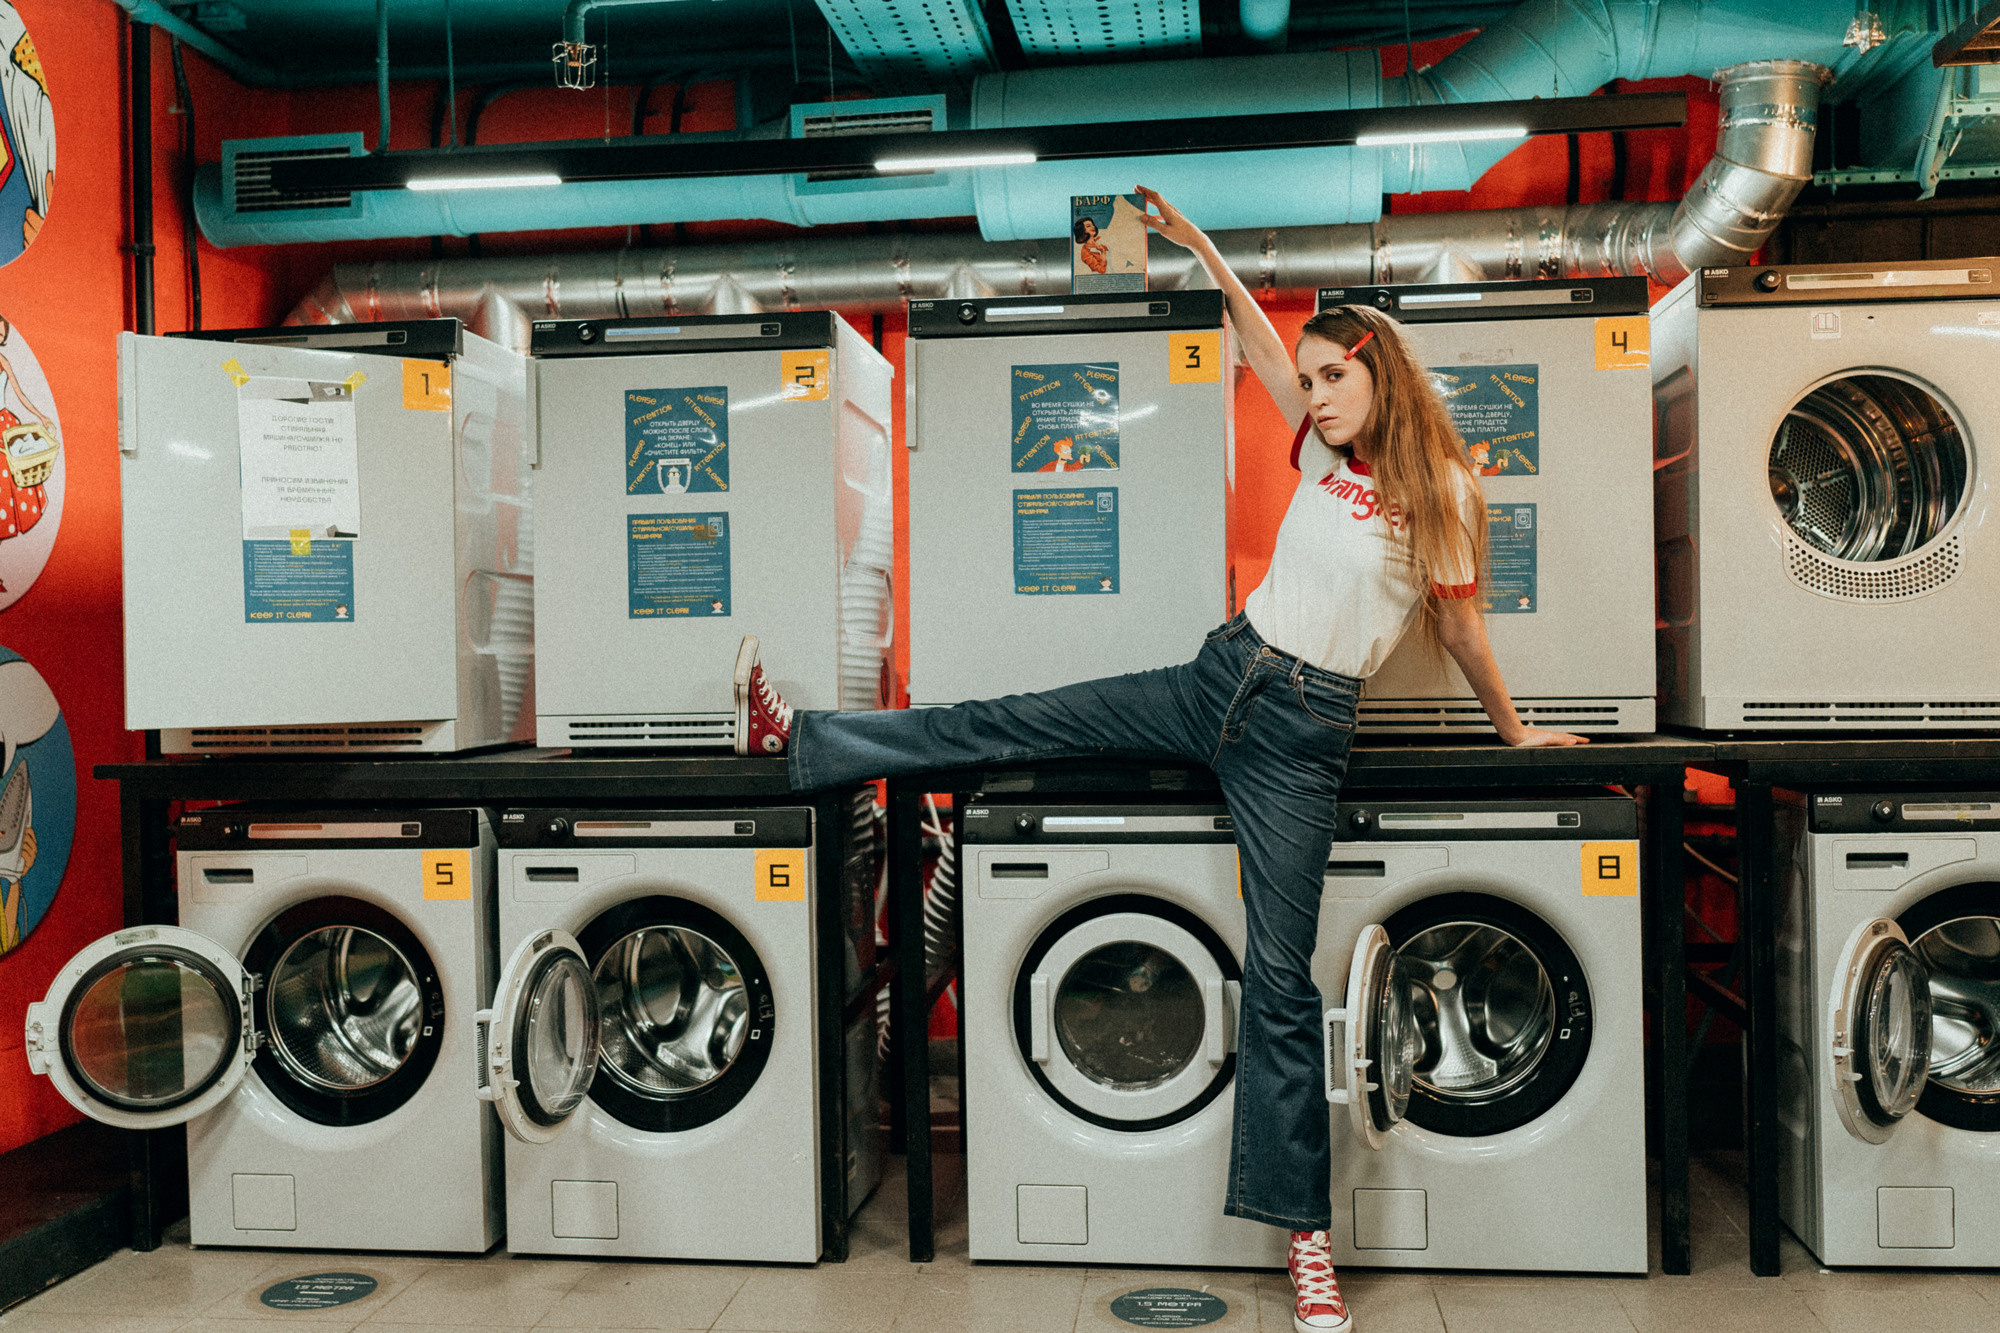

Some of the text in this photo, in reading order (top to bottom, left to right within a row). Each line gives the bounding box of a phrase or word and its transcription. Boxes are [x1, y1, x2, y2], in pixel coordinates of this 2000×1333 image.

[1612, 331, 1628, 354] 4
[1185, 346, 1200, 369] 3
[421, 373, 429, 396] 1
[436, 863, 453, 885] 5
[769, 864, 790, 887] 6
[1598, 855, 1620, 879] 8
